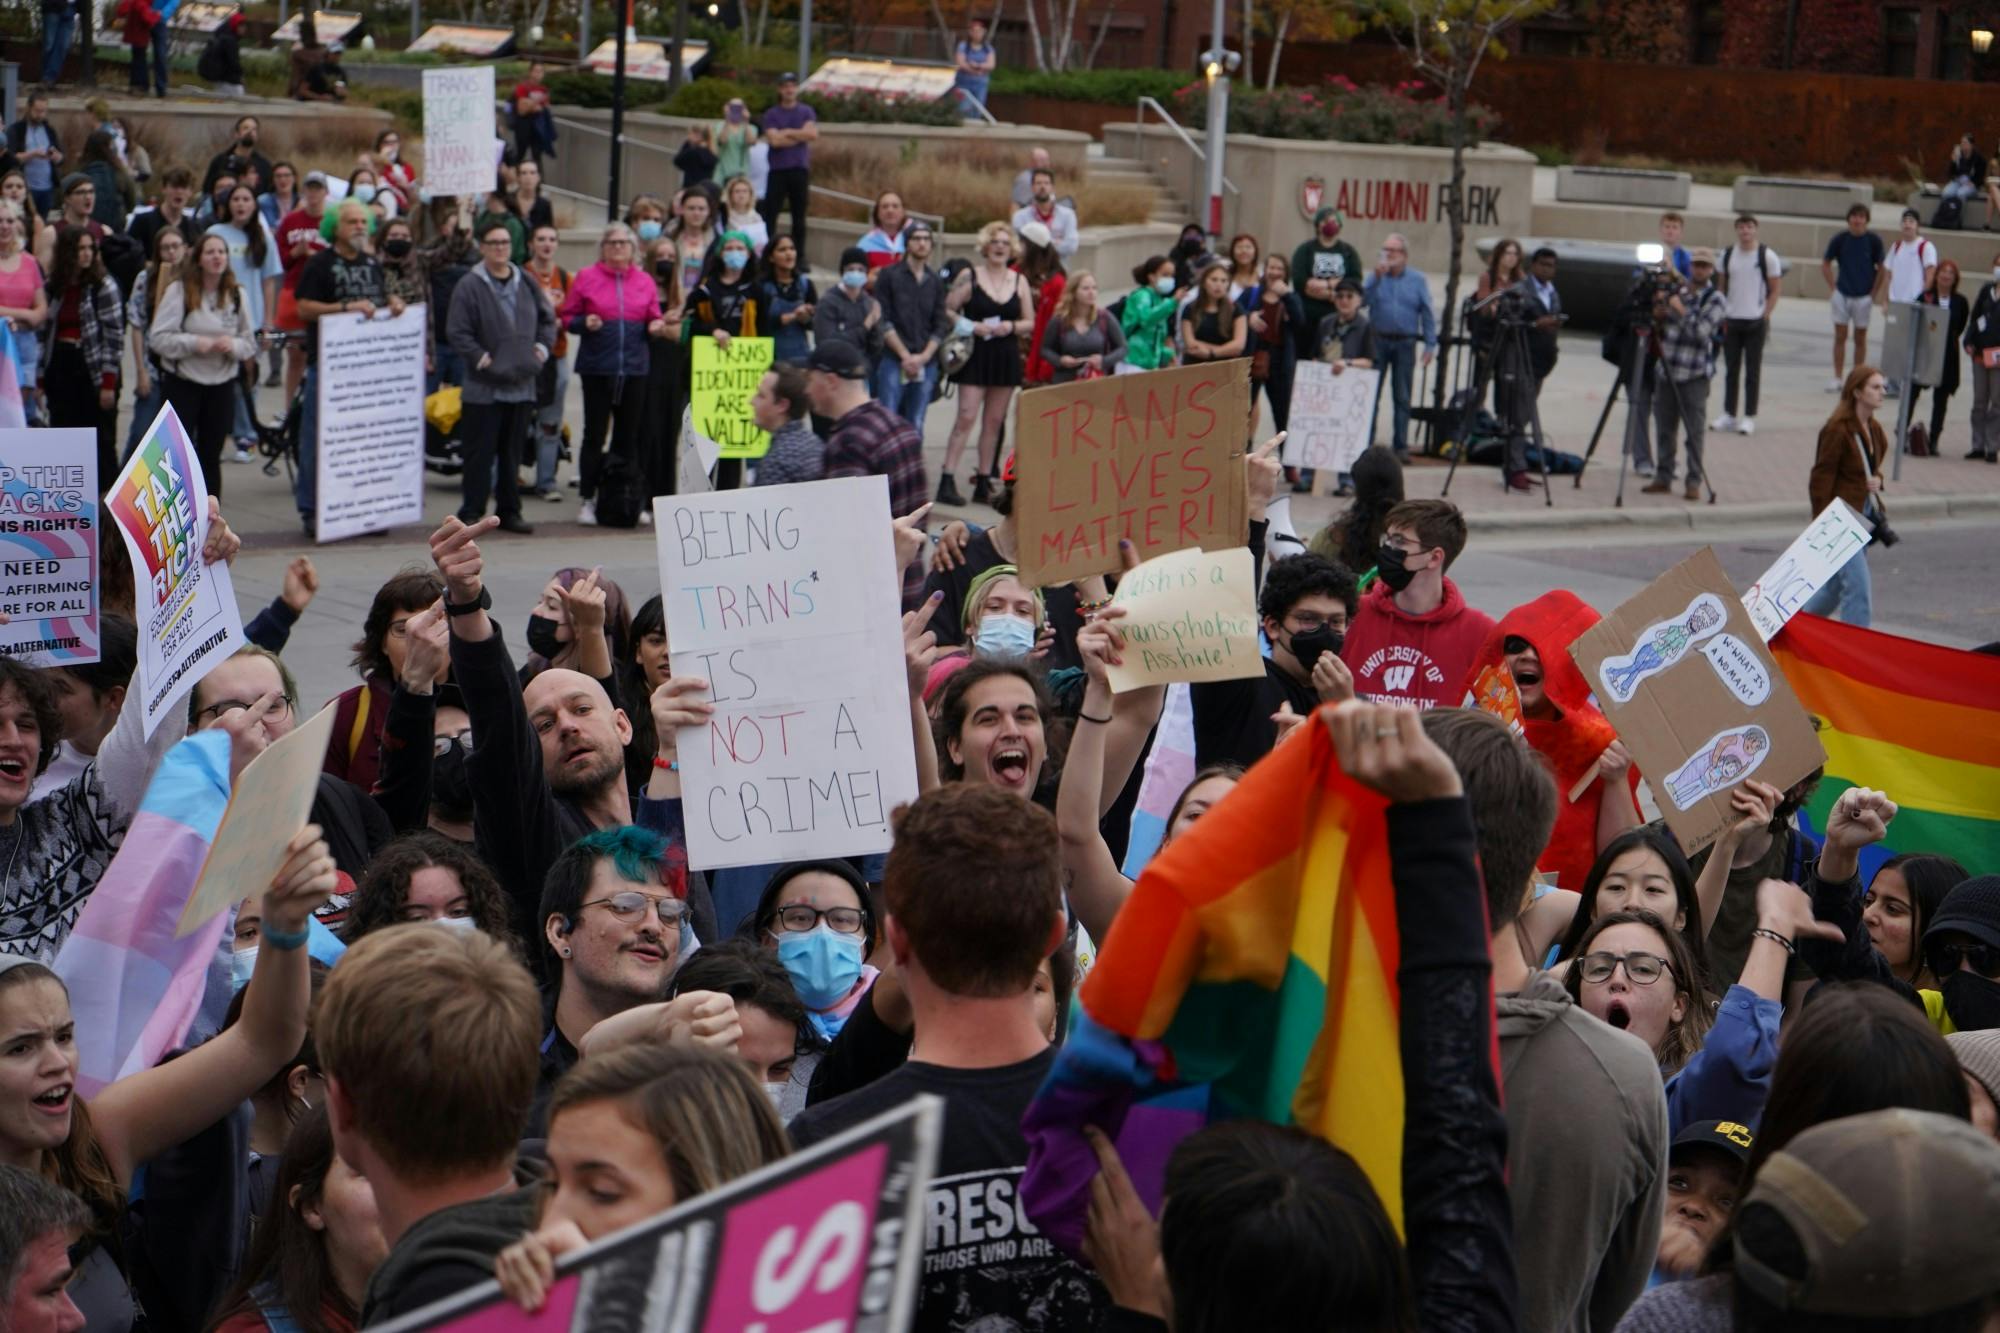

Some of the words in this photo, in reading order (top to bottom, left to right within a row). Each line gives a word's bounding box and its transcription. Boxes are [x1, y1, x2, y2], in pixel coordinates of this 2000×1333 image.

[1337, 178, 1429, 223] ALUMNI
[713, 342, 768, 365] TRANS
[714, 393, 748, 415] ARE
[1040, 380, 1217, 459] TRANS
[22, 466, 84, 489] THE
[134, 449, 182, 526] TAX
[1049, 446, 1213, 512] LIVES
[23, 517, 91, 532] RIGHTS
[150, 488, 192, 562] THE
[674, 506, 800, 568] BEING
[1040, 494, 1215, 567] MATTER!
[5, 560, 61, 577] NEED
[152, 519, 200, 607] RICH
[1179, 566, 1198, 586] is
[1210, 565, 1225, 586] a
[26, 600, 56, 613] FOR
[61, 599, 86, 611] ALL
[150, 588, 179, 632] COMBAT
[178, 560, 200, 594] LGBTQ
[151, 573, 201, 642] HOMELESSNESS
[13, 636, 82, 654] ALTERNATIVE
[160, 606, 194, 653] HOUSING
[163, 642, 178, 663] FOR
[178, 620, 194, 644] ALL!
[180, 627, 229, 675] ALTERNATIVE
[1119, 610, 1250, 649] ransphobic
[1711, 647, 1718, 656] A
[697, 649, 757, 704] IS
[1360, 645, 1432, 678] UNIVERSITY
[1425, 666, 1445, 683] OF
[1383, 665, 1416, 692] W
[1717, 656, 1755, 699] WOMAN?
[1722, 636, 1756, 673] W-WHAT
[1753, 674, 1765, 689] IS
[711, 710, 805, 766] NOT
[834, 703, 862, 751] A
[708, 769, 888, 842] CRIME!
[925, 1247, 978, 1274] THOSE
[980, 1240, 1017, 1264] WHO
